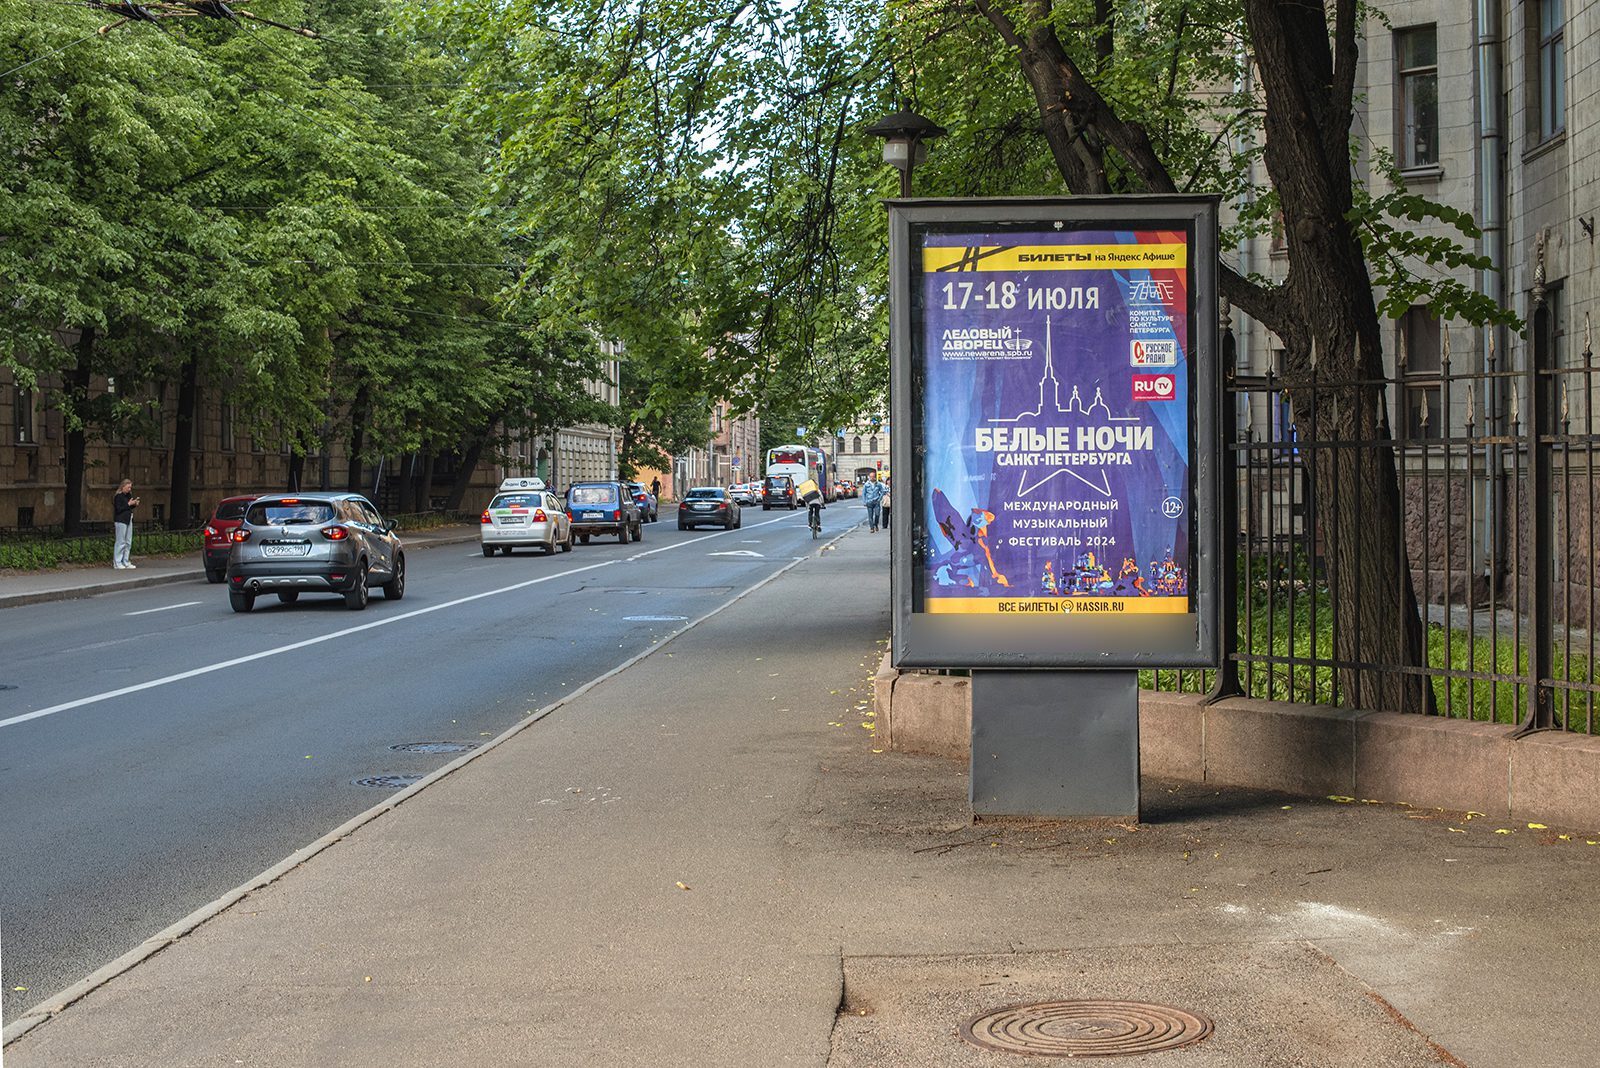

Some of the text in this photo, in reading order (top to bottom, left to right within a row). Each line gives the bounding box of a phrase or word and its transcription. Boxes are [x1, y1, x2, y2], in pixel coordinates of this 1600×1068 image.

[1018, 253, 1091, 263] БИЛЕТЫ
[1108, 252, 1141, 262] Яндекс
[1142, 252, 1175, 262] Афише
[942, 280, 1017, 310] 17-18
[942, 325, 1012, 340] ЛЕДОВЫЙ
[942, 339, 1004, 351] ДВОРЕЦ
[1145, 343, 1172, 353] РУССКОЕ
[942, 350, 1033, 358] www.newarena.spb.ru
[1145, 353, 1166, 363] РАДИО
[1134, 380, 1169, 392] RU TV
[975, 426, 1153, 452] БЕЛЫЕ НОЧИ
[996, 452, 1132, 466] САНКТ-ПЕТЕРБУРГА
[1003, 499, 1119, 512] МЕЖДУНАРОДНЫЙ
[1164, 501, 1182, 514] 12+
[1013, 517, 1108, 528] МУЗЫКАЛЬНЫЙ
[1008, 536, 1116, 547] ФЕСТИВАЛЬ 2024
[998, 602, 1124, 612] ВСЕ БИЛЕТЫ KASSIR.RU
